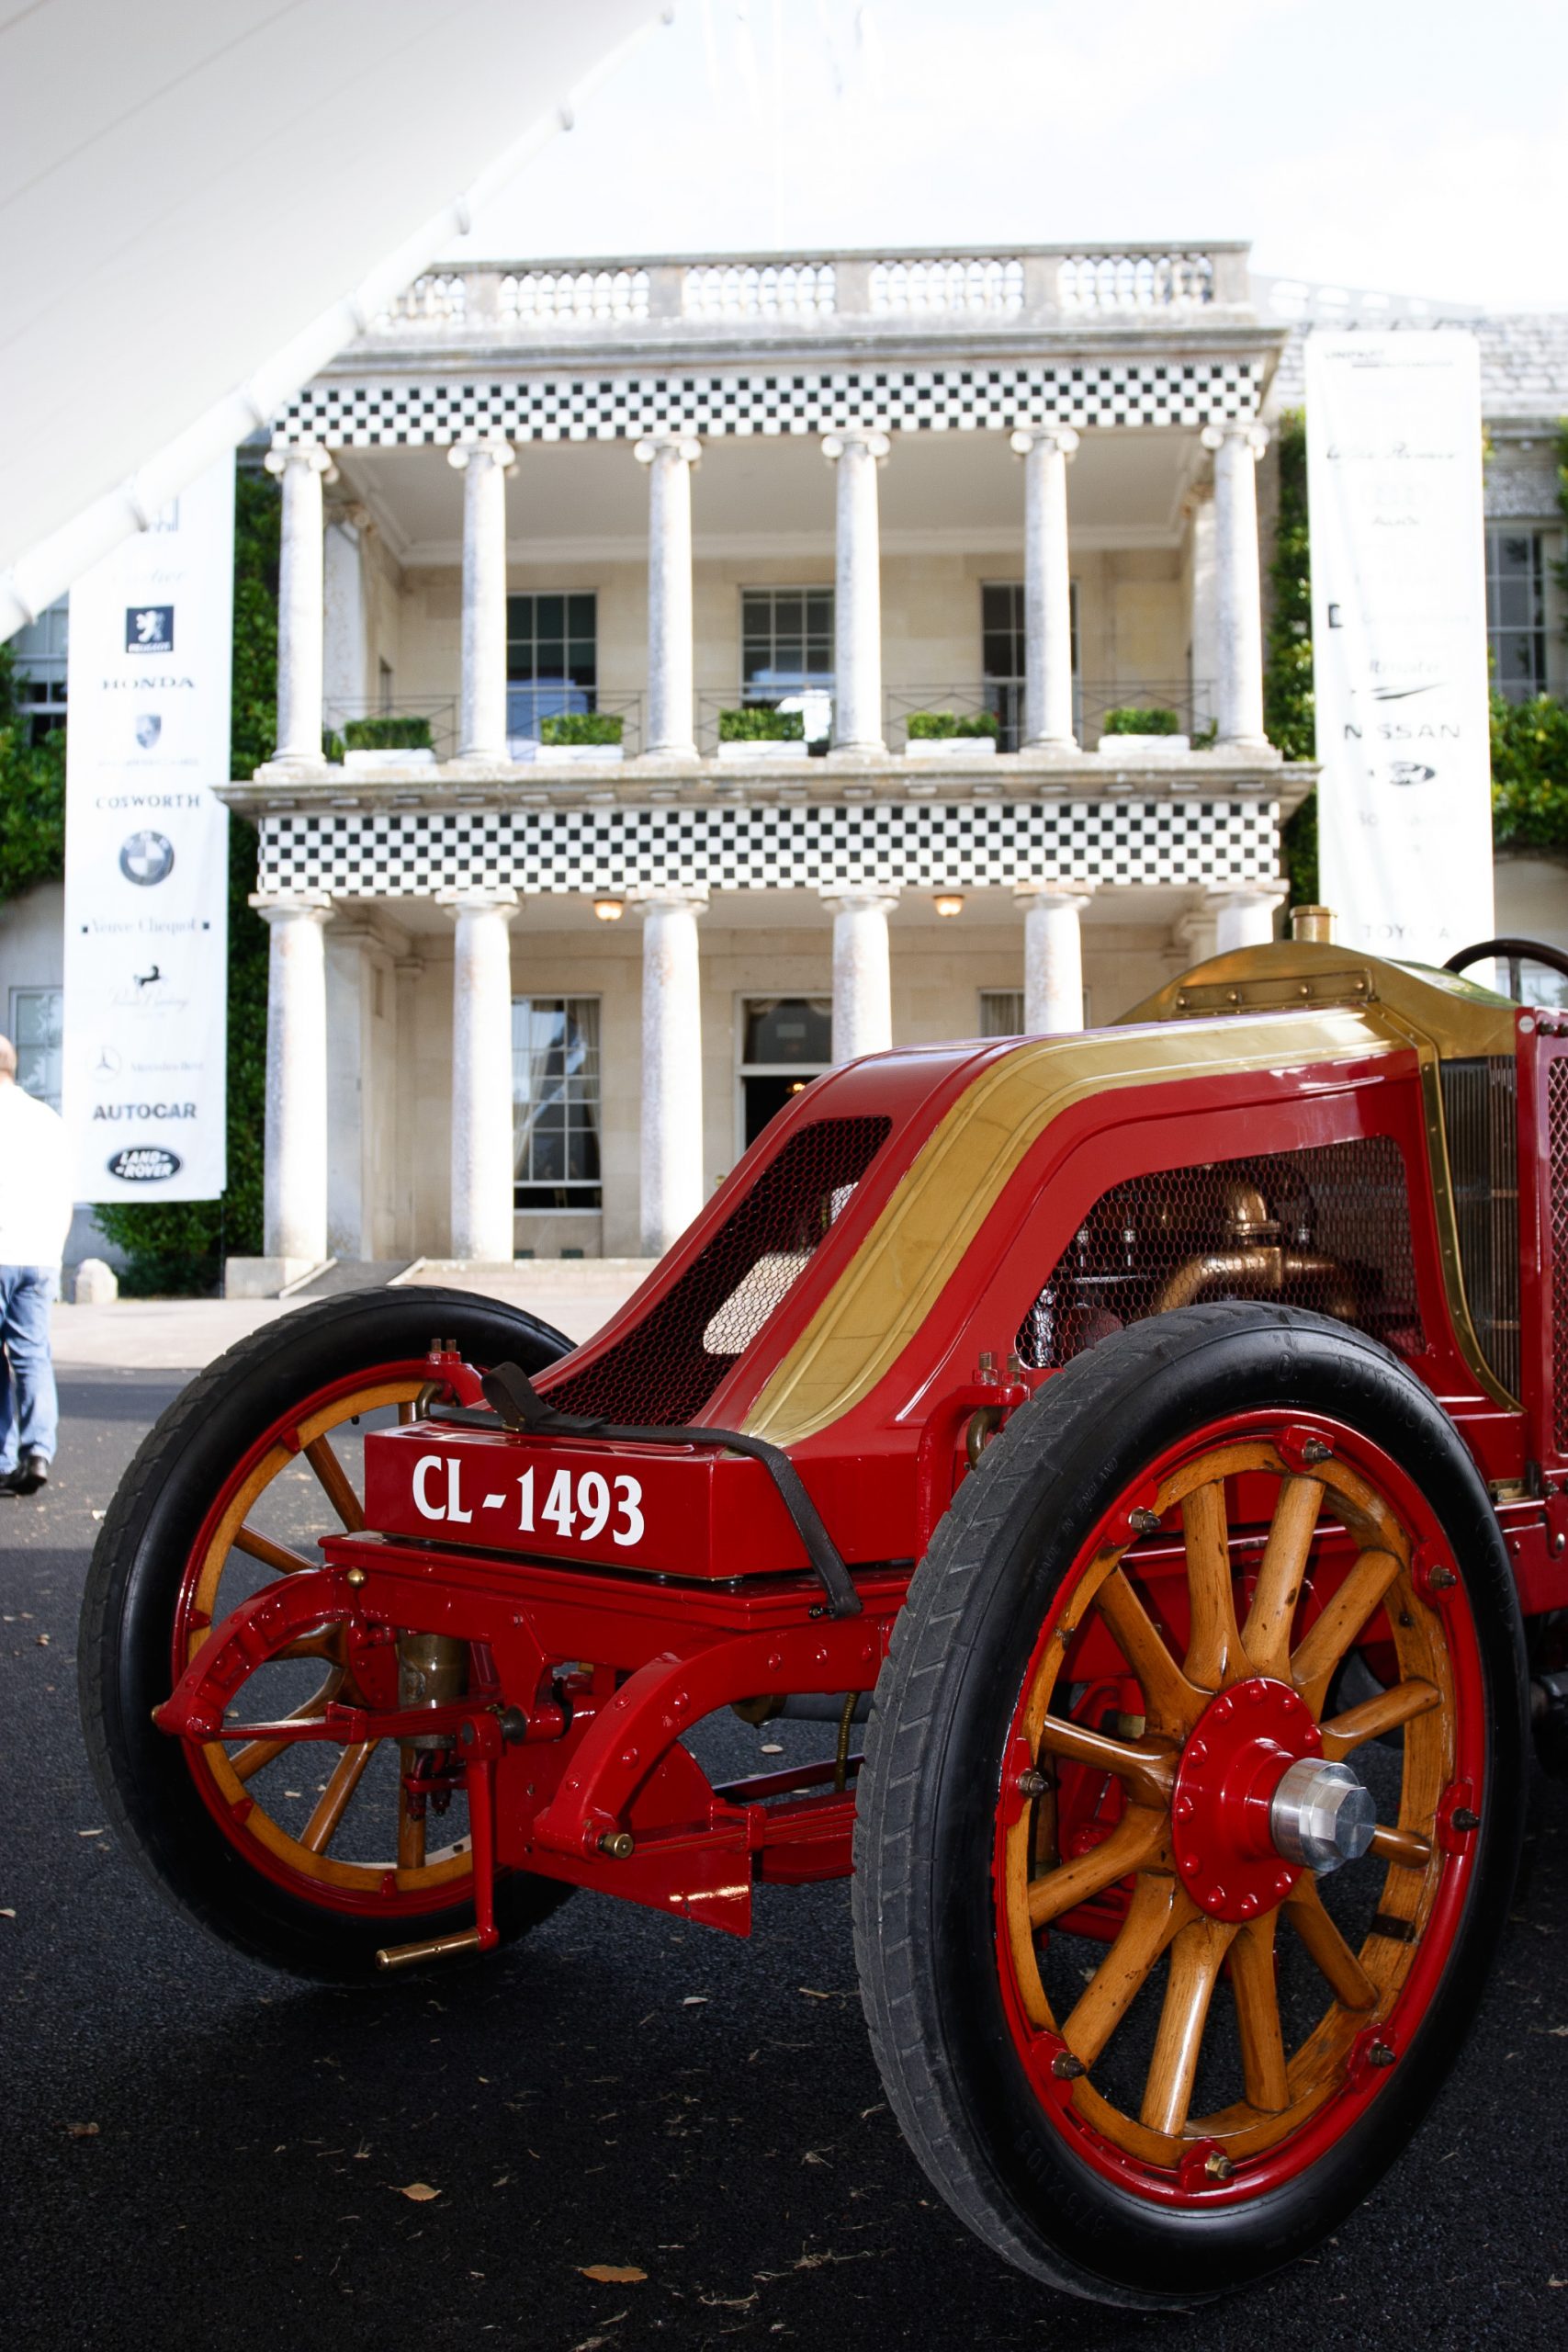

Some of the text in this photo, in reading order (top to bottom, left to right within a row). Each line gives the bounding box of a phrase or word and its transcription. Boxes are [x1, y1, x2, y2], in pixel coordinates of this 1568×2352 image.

[103, 677, 195, 690] HONDA
[96, 795, 200, 808] COSWORTH
[93, 1102, 197, 1121] AUTOCAR
